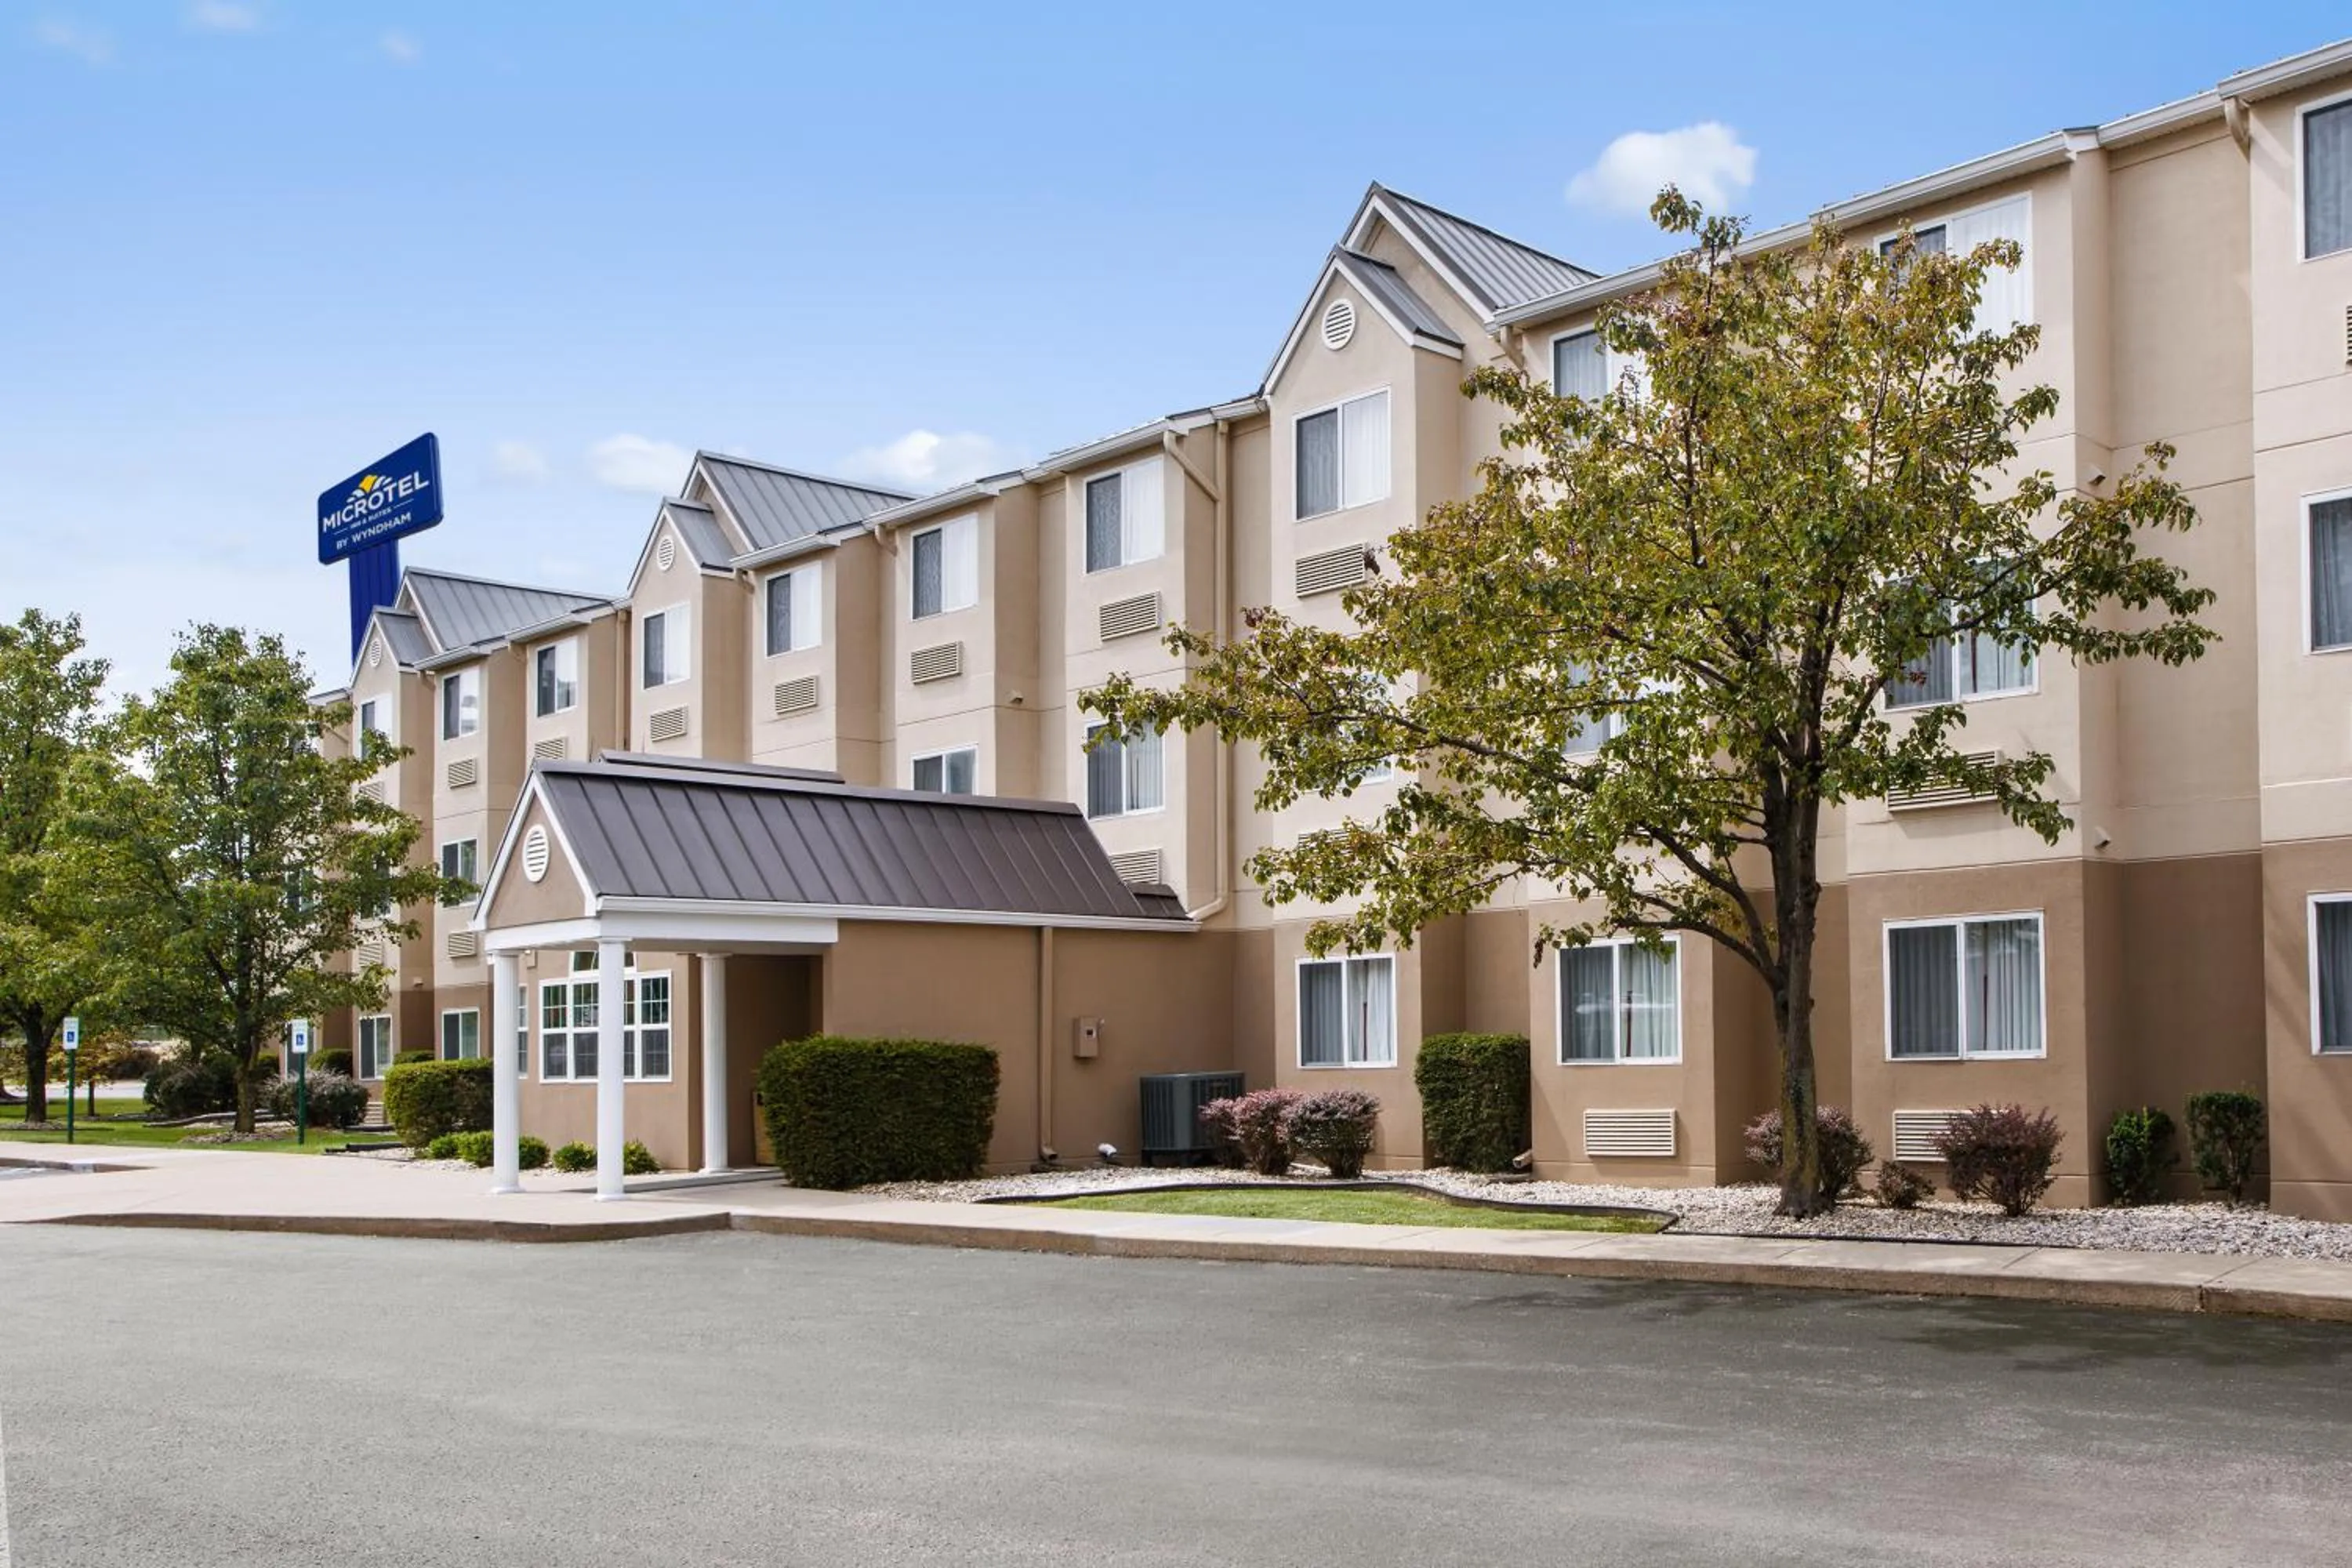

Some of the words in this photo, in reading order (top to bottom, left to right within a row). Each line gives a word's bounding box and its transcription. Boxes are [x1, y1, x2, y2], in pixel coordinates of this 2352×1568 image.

[322, 471, 429, 532] MICROTEL
[336, 538, 348, 550] BY
[352, 512, 412, 543] WYNDHAM
